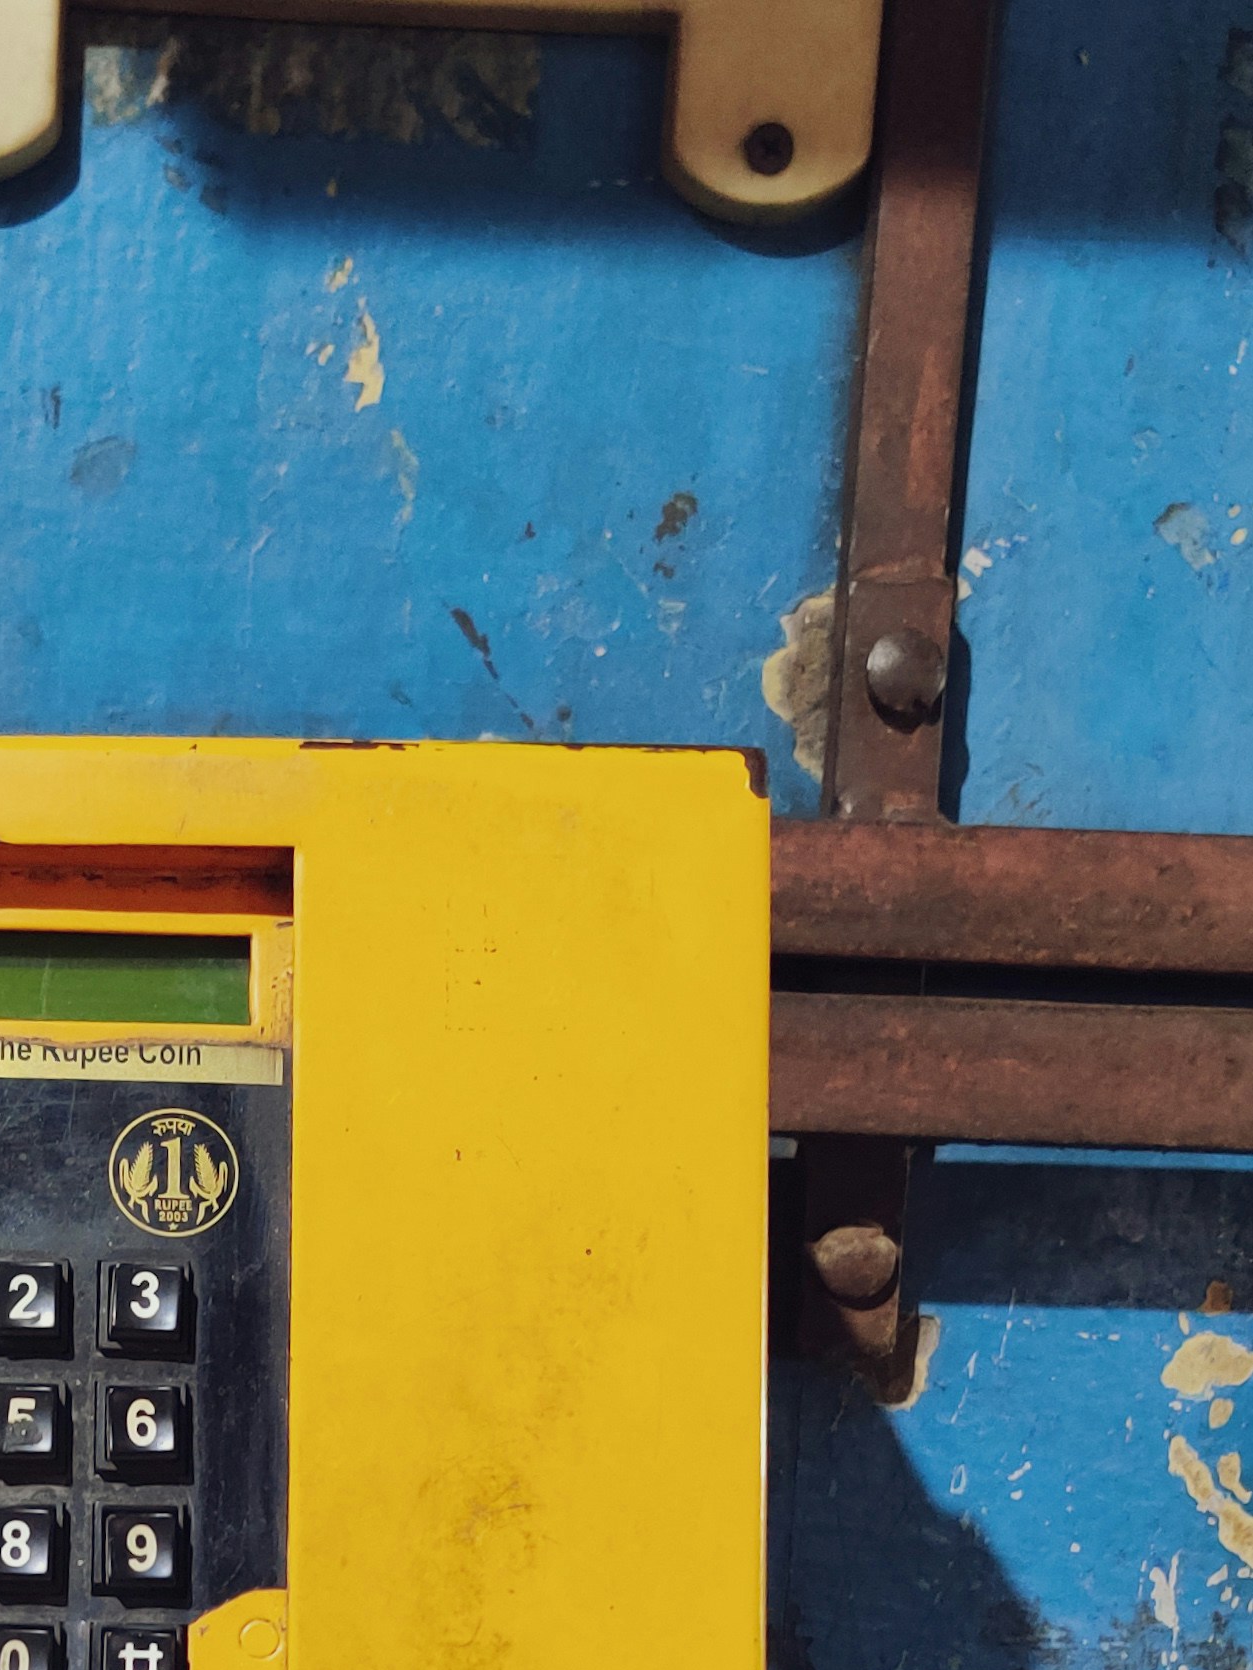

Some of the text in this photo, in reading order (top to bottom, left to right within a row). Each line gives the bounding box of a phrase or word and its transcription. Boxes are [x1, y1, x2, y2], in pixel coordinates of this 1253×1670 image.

[42, 1045, 129, 1069] Rupee
[139, 1044, 201, 1066] Coin
[159, 1136, 190, 1199] 1
[154, 1199, 192, 1211] RUPEE
[158, 1211, 188, 1222] 2003
[8, 1273, 41, 1321] 2
[129, 1271, 160, 1319] 3
[6, 1397, 42, 1446] 5
[126, 1399, 157, 1447] 6
[1, 1520, 31, 1567] 8
[126, 1524, 158, 1573] 9
